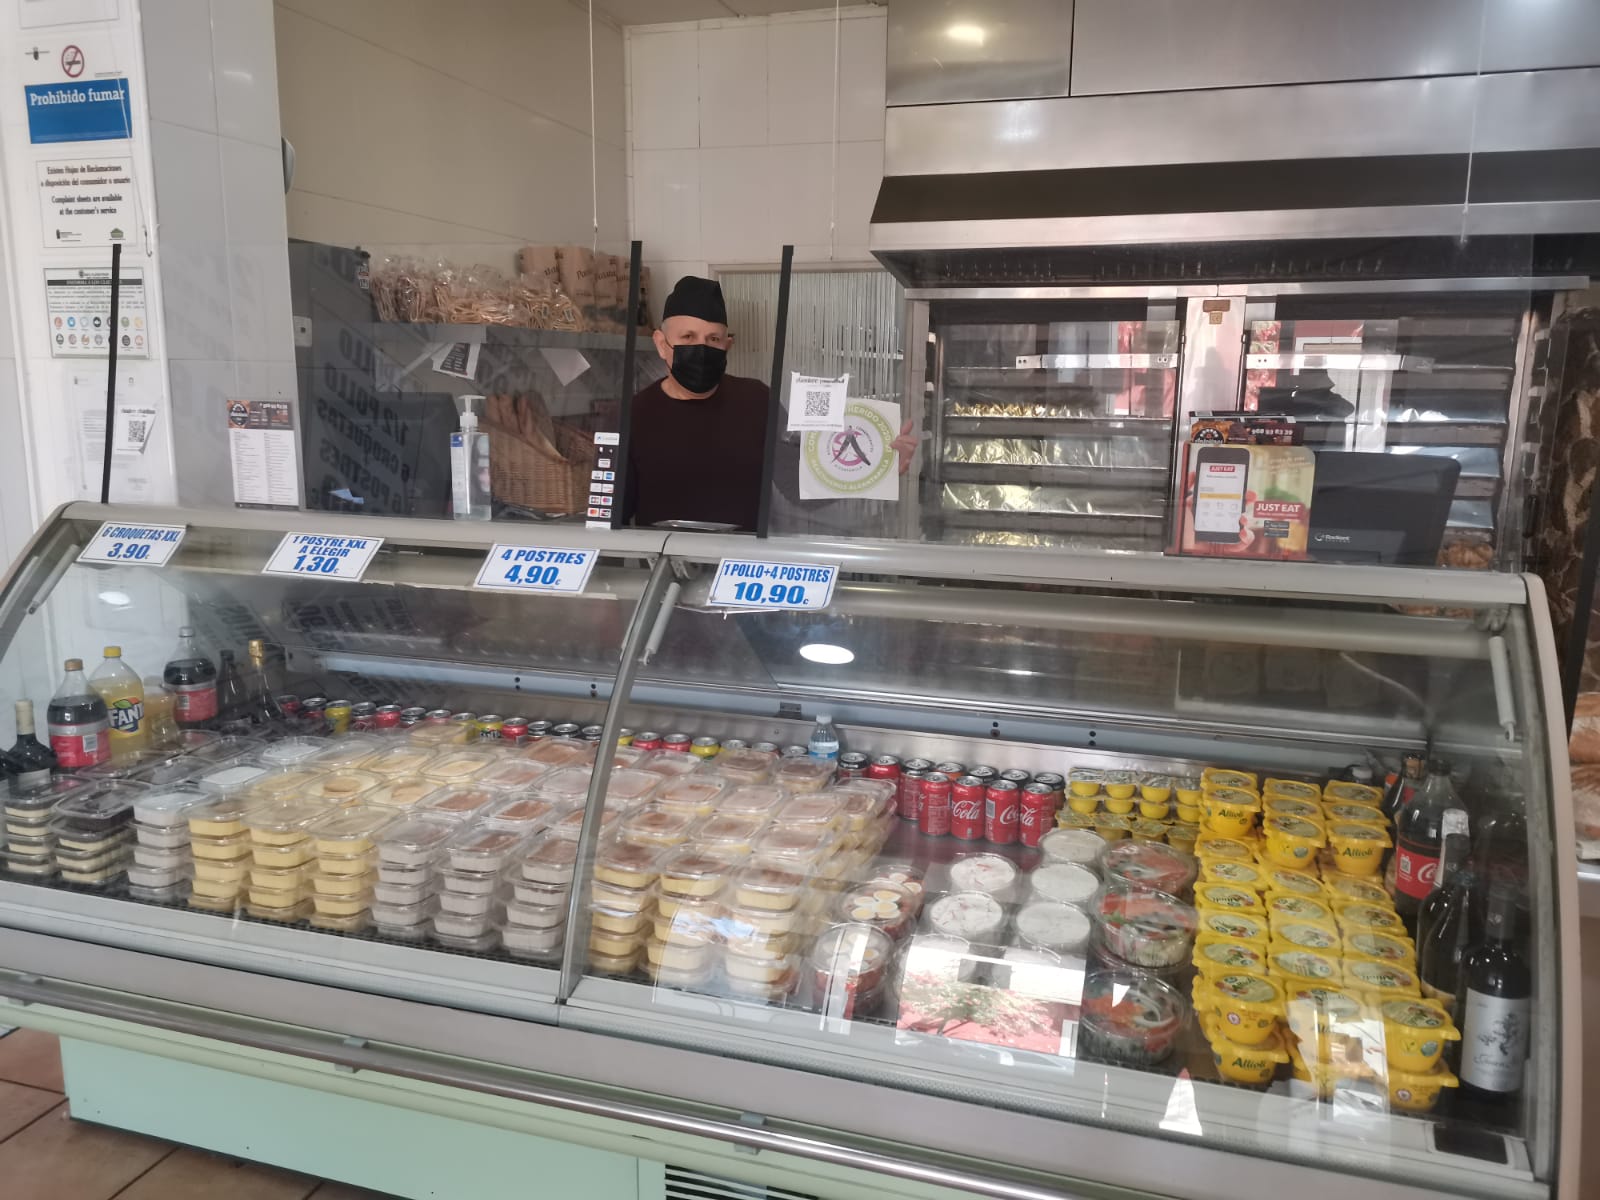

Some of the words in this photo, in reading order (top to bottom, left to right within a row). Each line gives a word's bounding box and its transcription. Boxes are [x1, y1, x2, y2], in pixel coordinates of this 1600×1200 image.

[30, 89, 86, 106] Prohibido
[88, 87, 125, 102] fumar
[65, 166, 79, 175] Hojas
[52, 195, 75, 204] Complaint
[102, 193, 122, 202] available
[74, 206, 99, 215] customer's
[101, 206, 117, 214] service
[1256, 503, 1280, 512] JUST
[1281, 504, 1301, 513] EAT
[102, 526, 113, 538] 6
[110, 527, 164, 541] CROQUETAS
[161, 530, 181, 542] XXL
[293, 536, 300, 544] 1
[300, 535, 346, 547] POSTRE
[346, 539, 367, 549] XXL
[299, 545, 308, 554] A
[310, 546, 350, 557] ELEGIR
[501, 549, 514, 561] 4
[514, 550, 586, 565] POSTRES
[724, 563, 730, 576] 1
[780, 567, 830, 583] POSTRES
[953, 800, 981, 820] Cola
[1343, 847, 1374, 858] Allioli
[1232, 1057, 1266, 1070] Allioli
